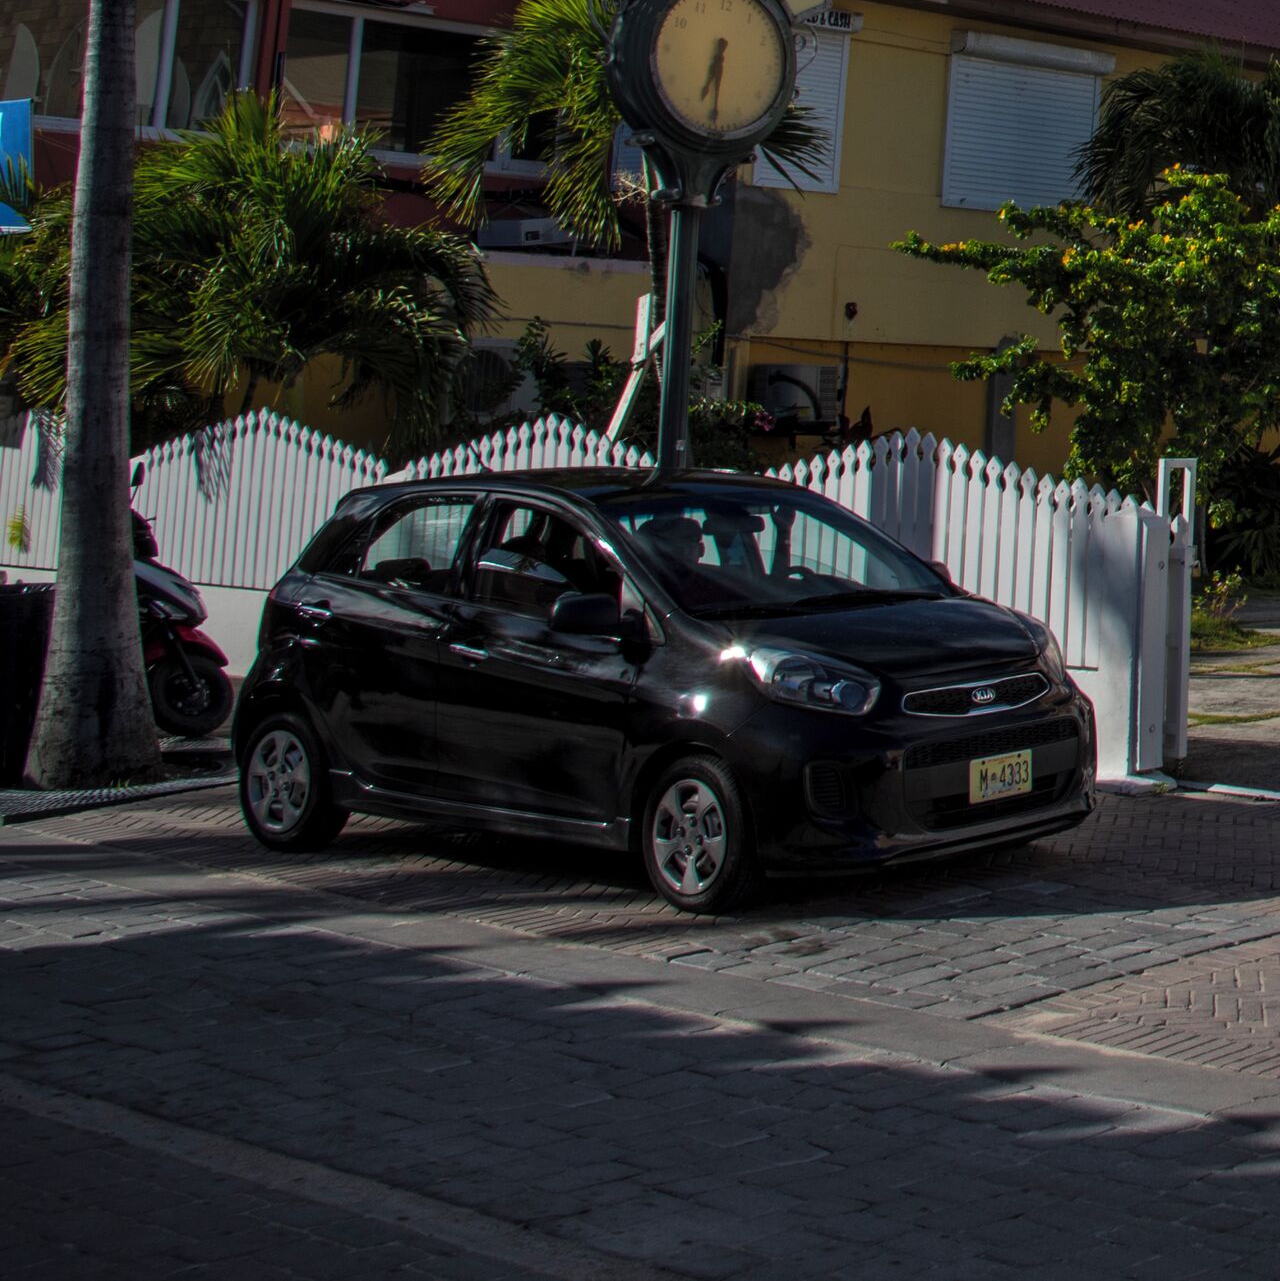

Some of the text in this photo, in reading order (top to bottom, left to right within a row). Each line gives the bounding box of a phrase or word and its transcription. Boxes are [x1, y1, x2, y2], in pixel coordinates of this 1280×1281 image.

[695, 1, 706, 14] 11
[720, 0, 732, 12] 12
[674, 17, 687, 29] 10
[829, 11, 851, 29] CASH
[976, 690, 993, 700] KIA
[980, 760, 1029, 792] M 4333
